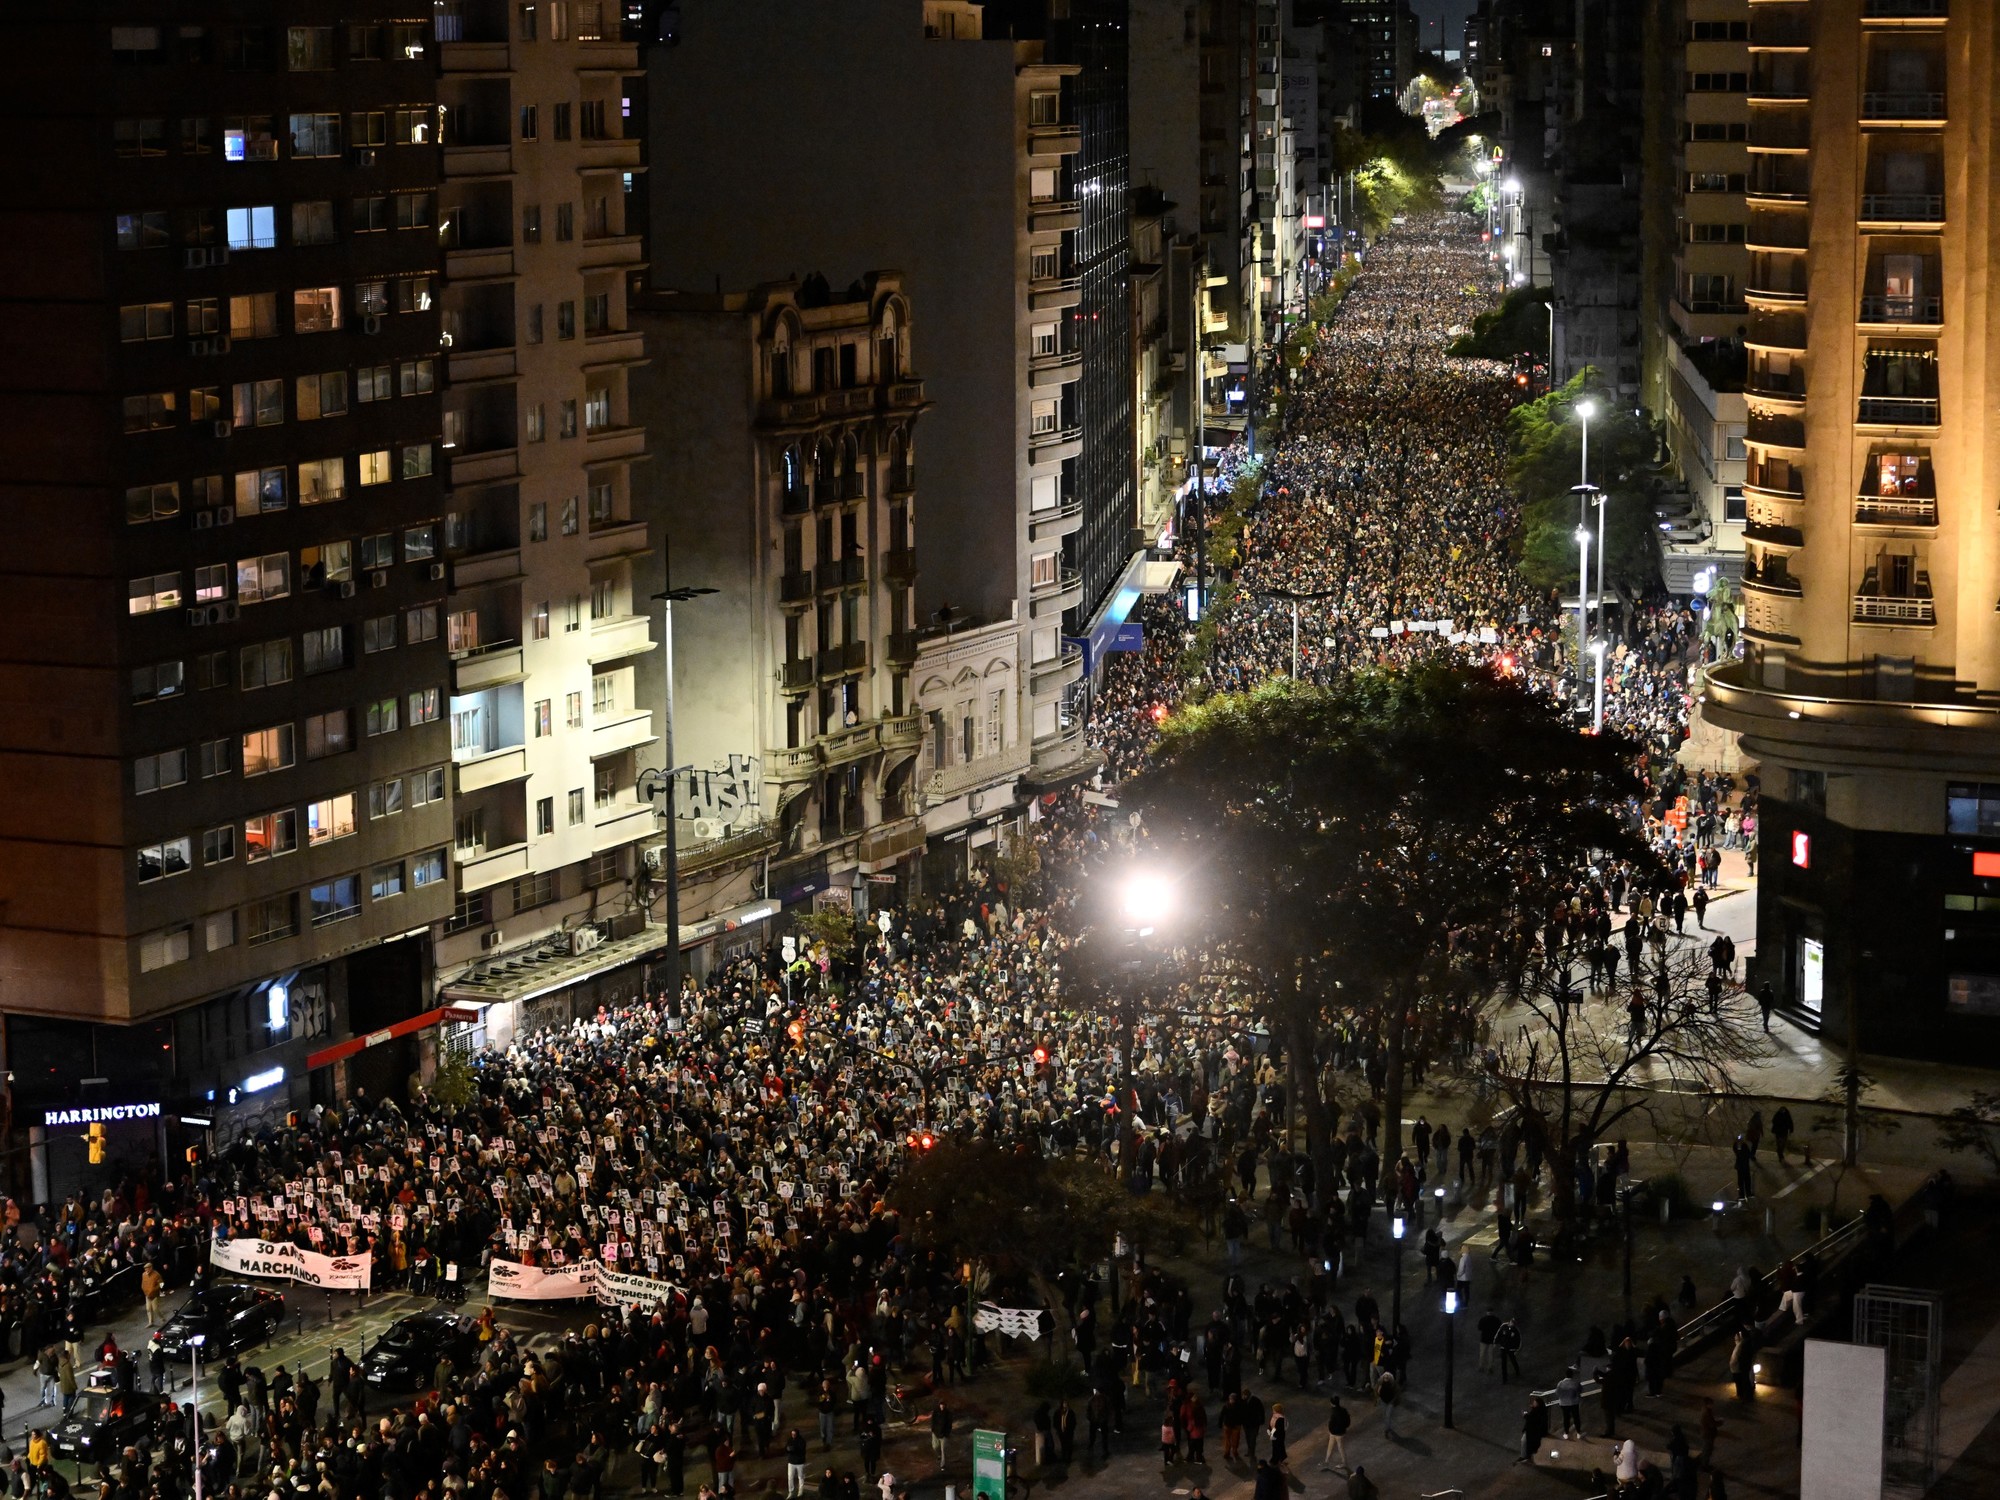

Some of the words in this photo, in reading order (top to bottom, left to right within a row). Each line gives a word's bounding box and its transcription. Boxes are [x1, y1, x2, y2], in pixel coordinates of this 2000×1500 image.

[45, 1103, 160, 1125] HARRINGTON
[256, 1242, 275, 1254] 30
[240, 1259, 321, 1285] MARCHANDO
[580, 1263, 592, 1271] la
[630, 1277, 644, 1287] de
